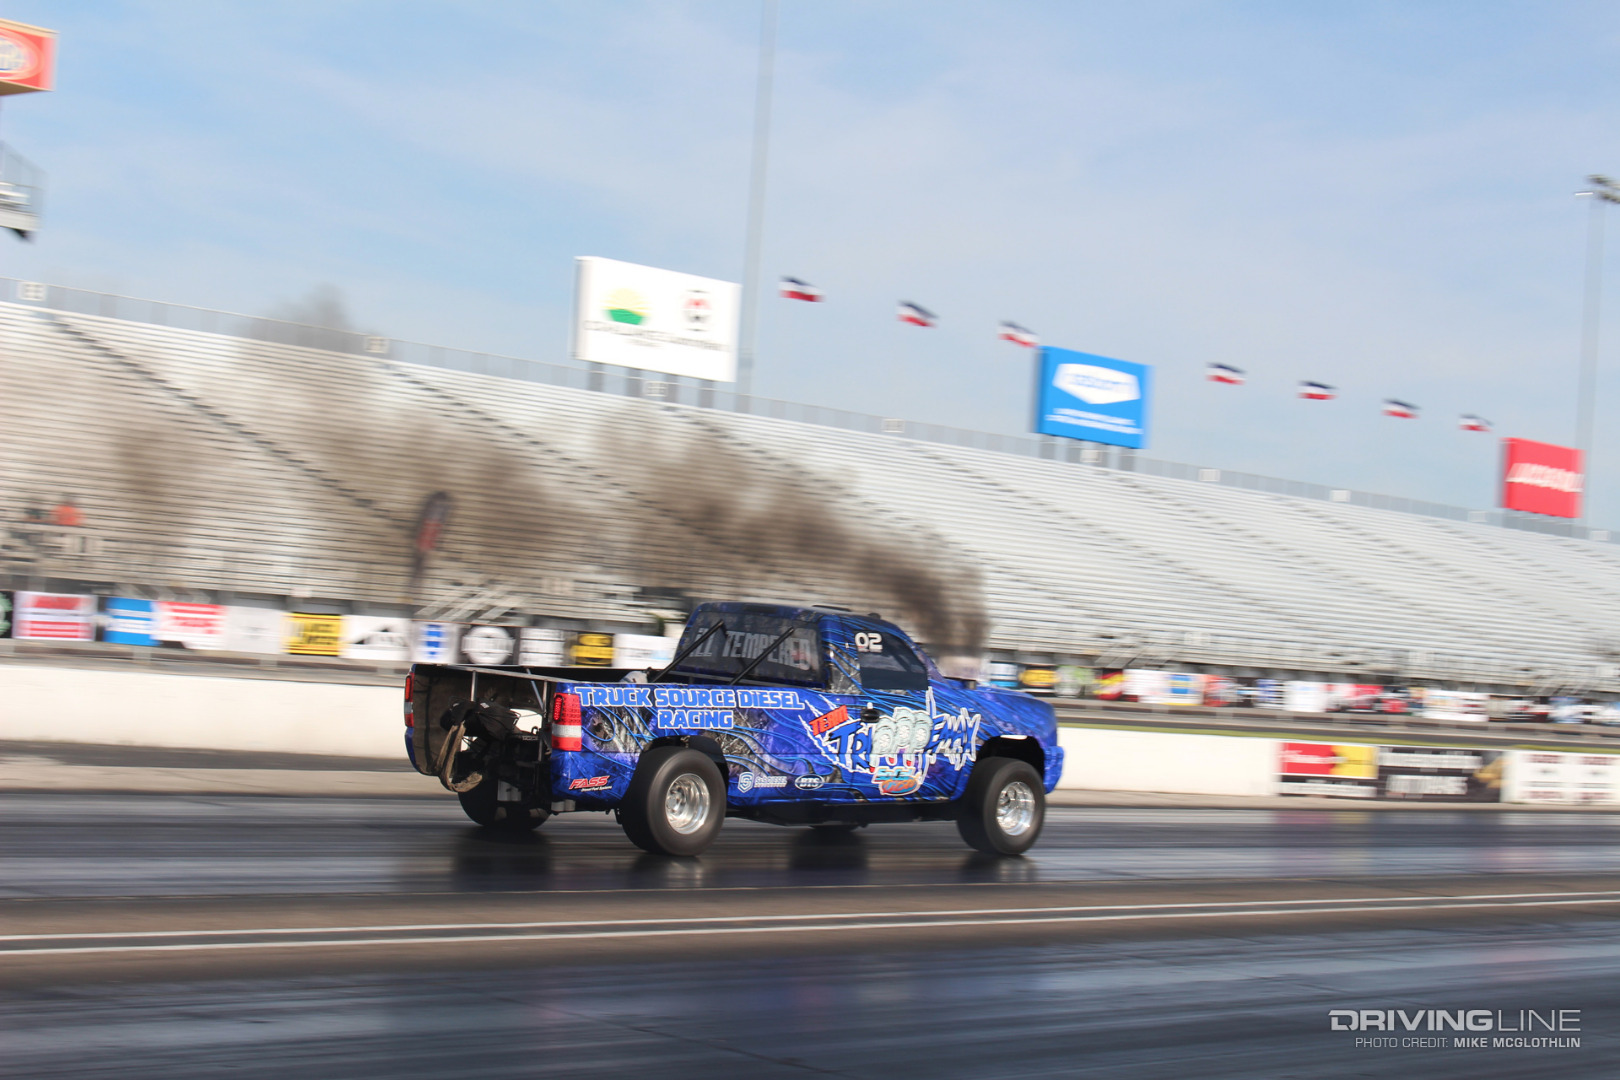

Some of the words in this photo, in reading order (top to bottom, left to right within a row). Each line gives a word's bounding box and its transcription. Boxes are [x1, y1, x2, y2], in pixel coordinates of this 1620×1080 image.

[855, 632, 883, 649] 02
[575, 687, 653, 707] TRUCK
[654, 688, 736, 708] SOURCE
[738, 690, 805, 709] DIESEL
[657, 709, 734, 729] RACING
[568, 775, 610, 790] FASS
